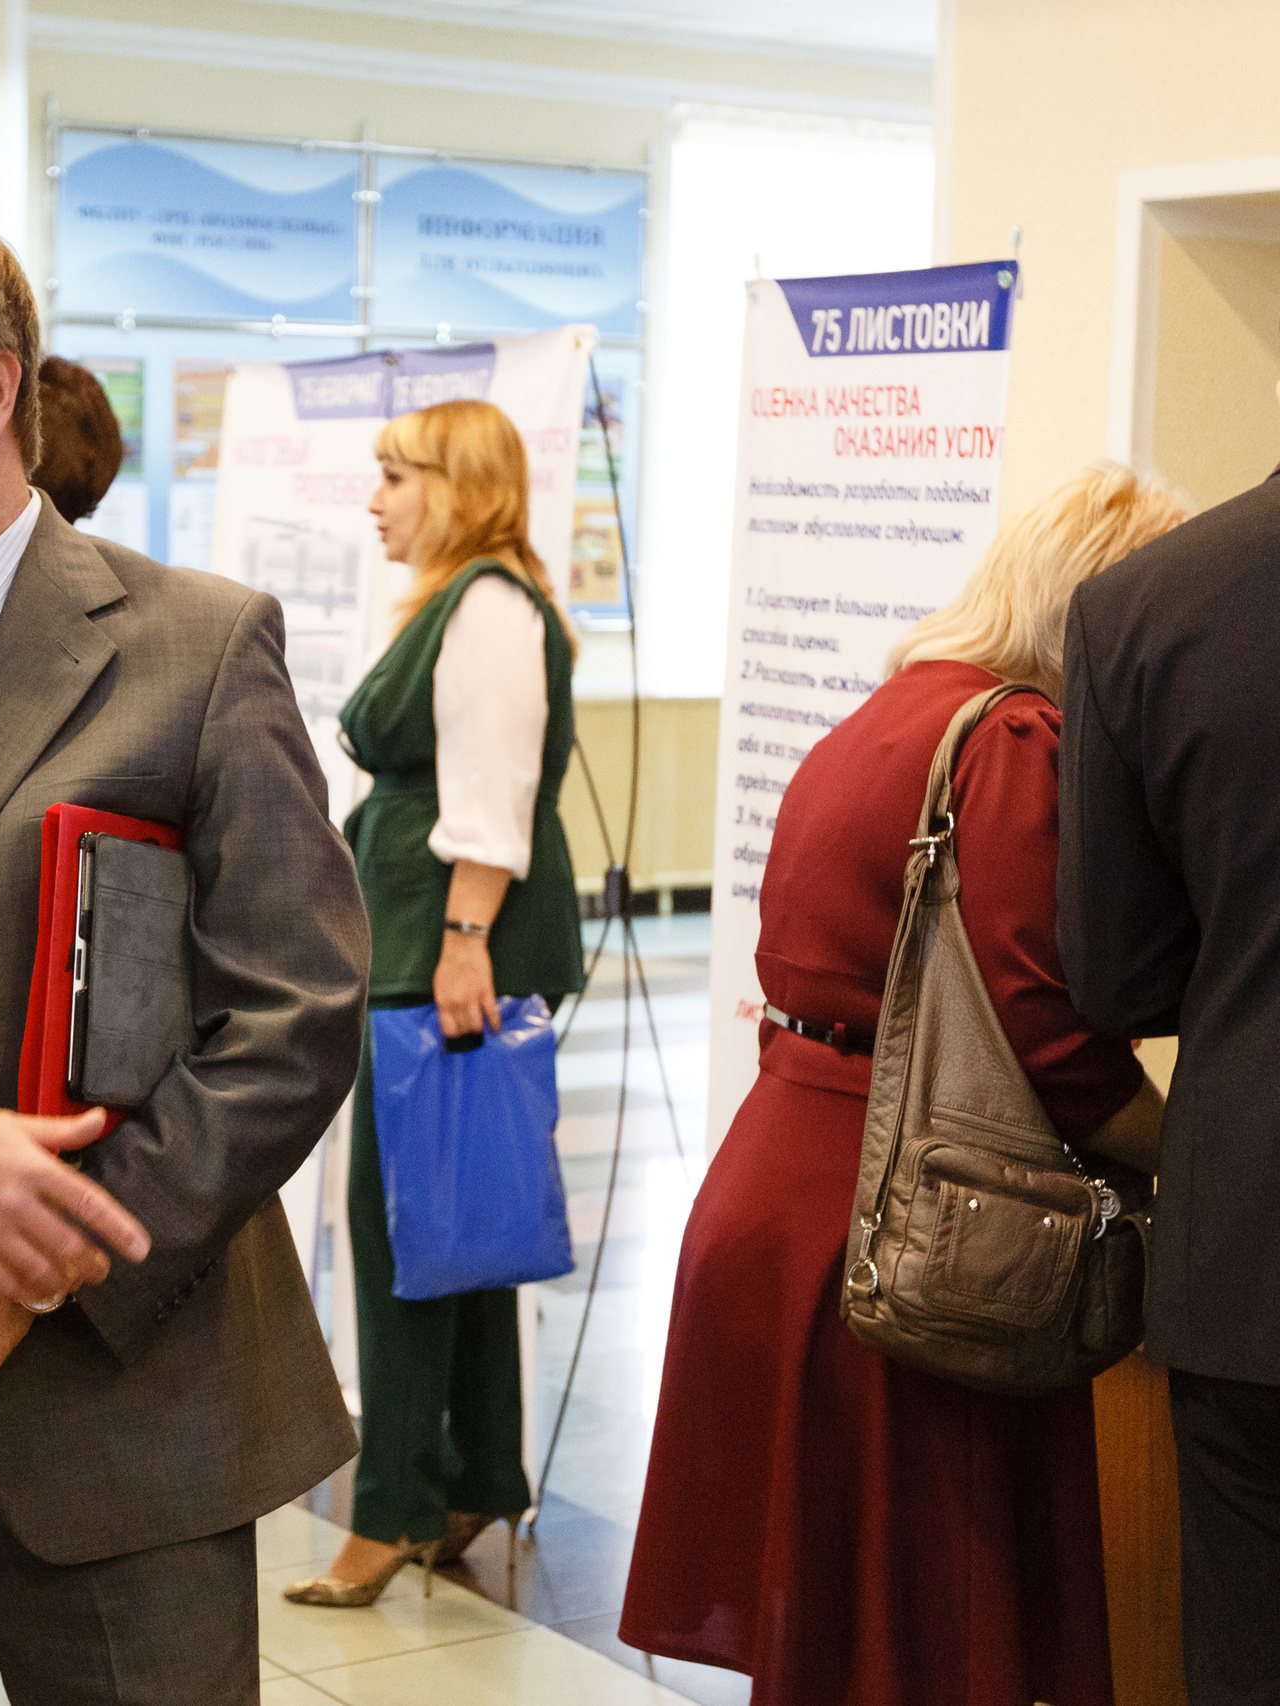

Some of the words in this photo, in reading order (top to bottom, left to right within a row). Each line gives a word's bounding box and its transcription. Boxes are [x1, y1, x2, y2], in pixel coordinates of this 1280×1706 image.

[811, 308, 843, 352] 75
[846, 300, 990, 351] ЛИСТОВКИ
[751, 386, 819, 417] ОЦЕНКА
[825, 384, 921, 417] КАЧЕСТВА
[834, 425, 937, 457] ОКАЗАНИЯ
[924, 480, 991, 504] подобных
